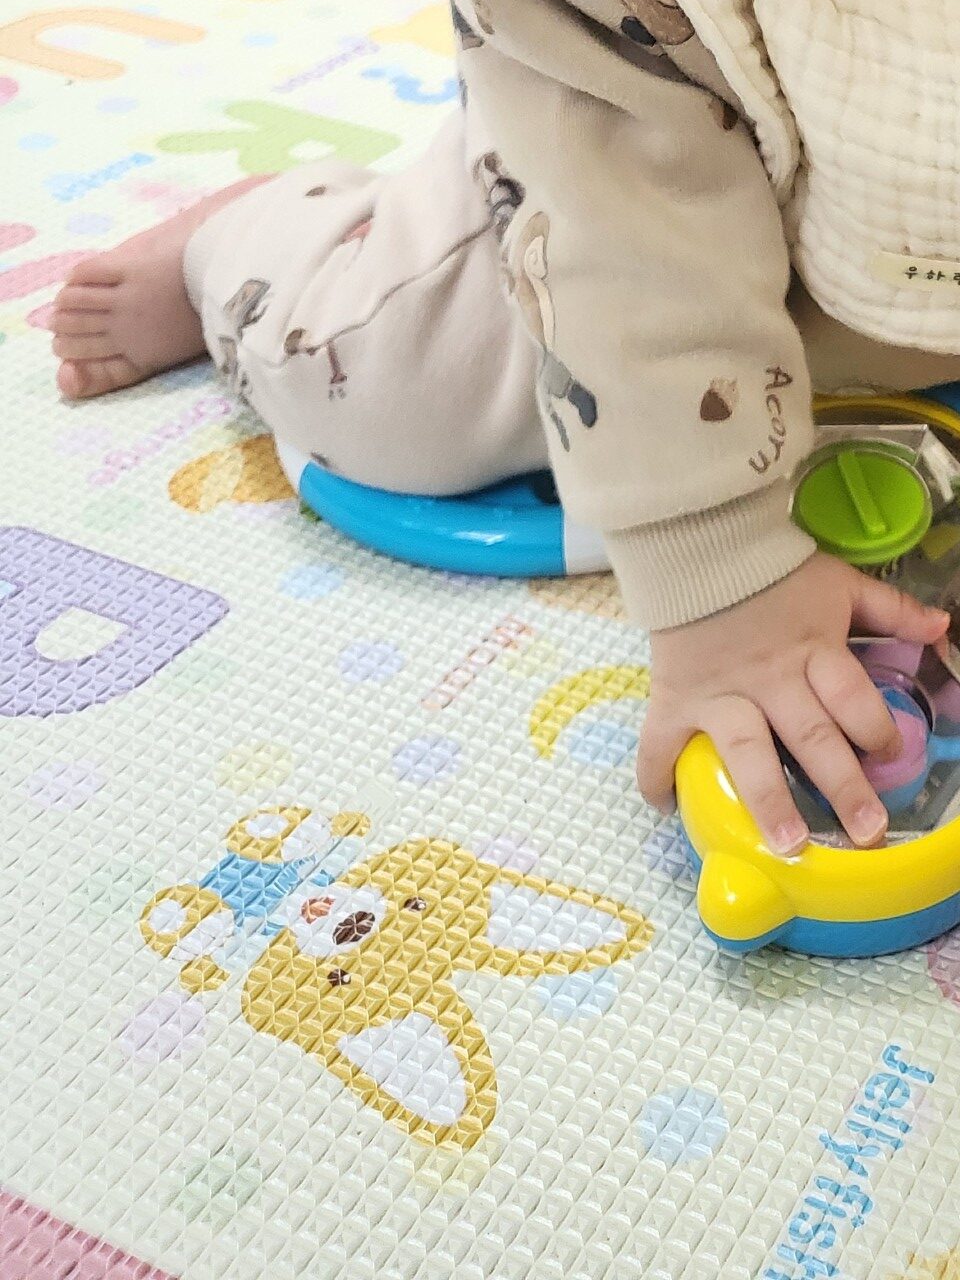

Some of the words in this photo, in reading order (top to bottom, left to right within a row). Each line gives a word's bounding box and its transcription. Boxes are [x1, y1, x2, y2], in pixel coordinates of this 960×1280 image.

[748, 365, 794, 474] Acorn
[818, 1044, 936, 1178] Jelly
[763, 1175, 875, 1280] fish
